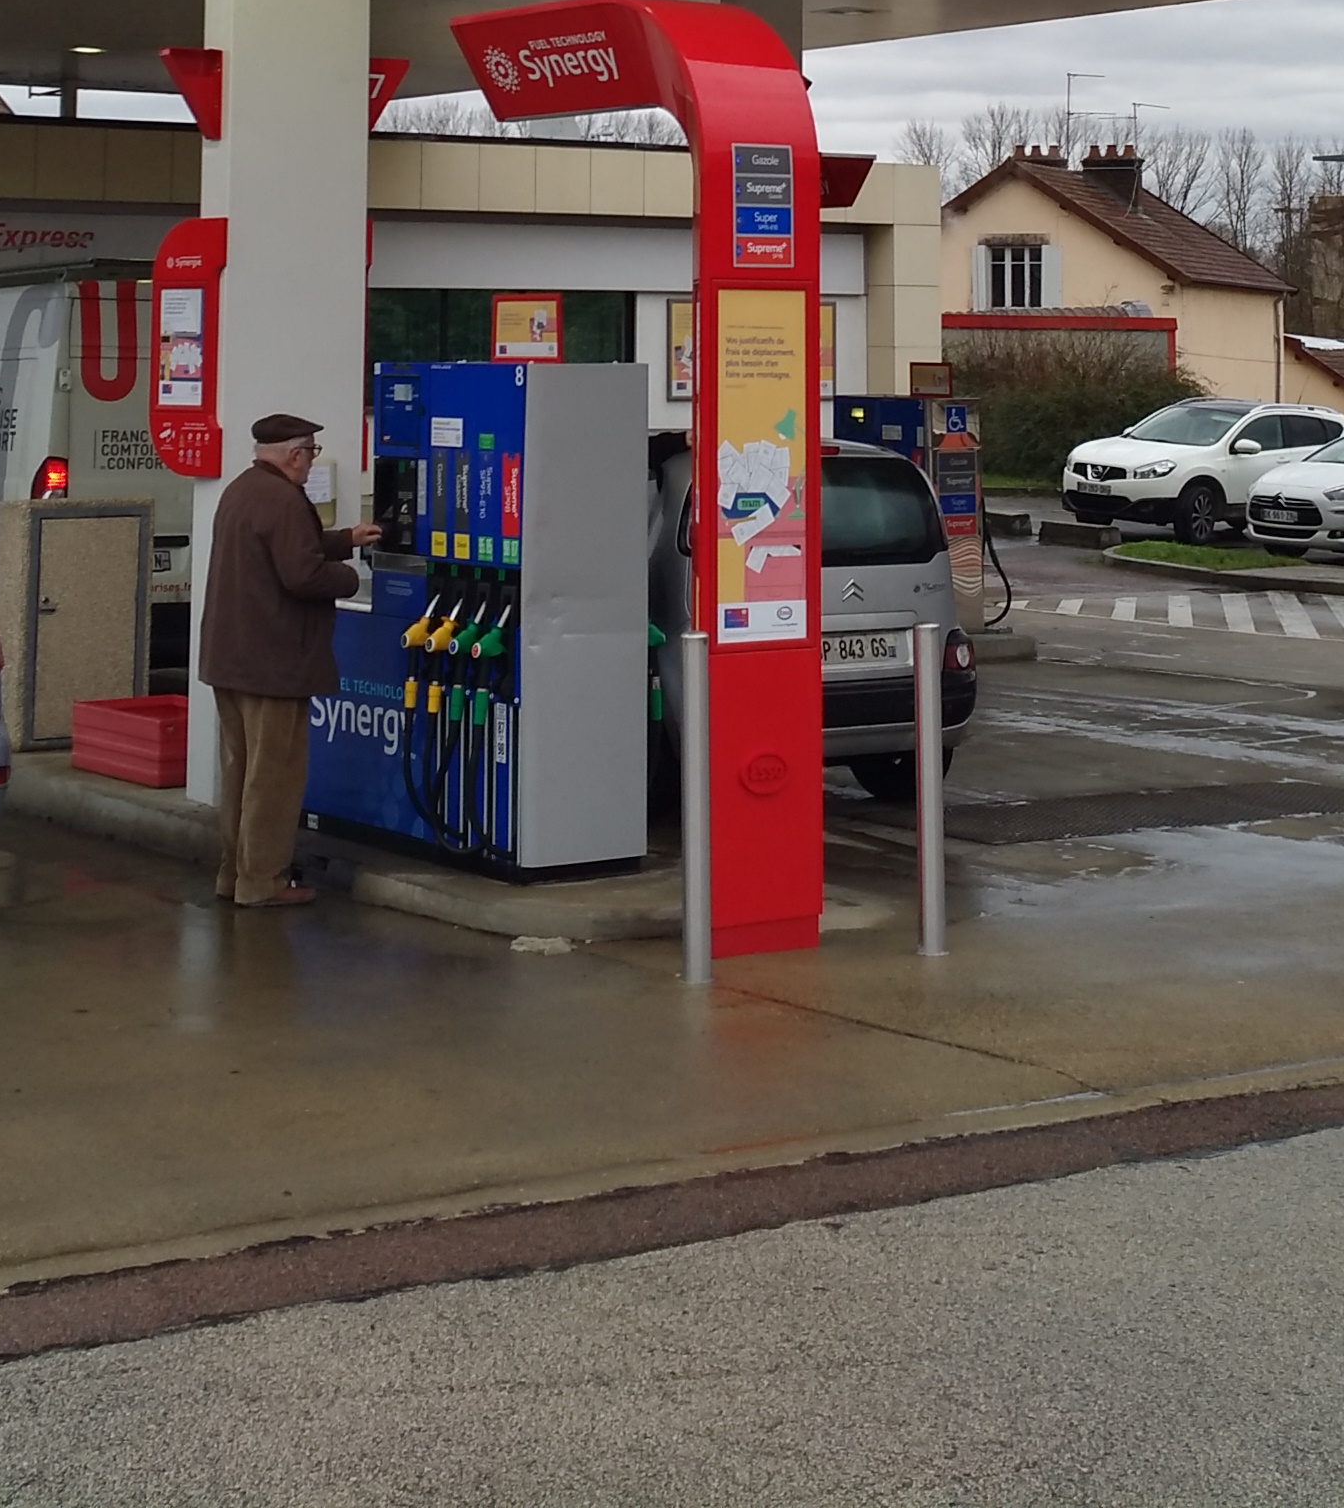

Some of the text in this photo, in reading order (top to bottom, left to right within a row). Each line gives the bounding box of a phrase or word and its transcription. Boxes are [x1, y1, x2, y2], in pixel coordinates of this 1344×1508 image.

[528, 30, 607, 50] FUEL TECHNOLOGY
[518, 46, 620, 88] Synergy
[369, 73, 386, 99] 7
[751, 154, 780, 166] Gazole
[754, 211, 778, 224] Super
[515, 365, 524, 386] 8
[101, 430, 149, 443] FRANC
[101, 443, 157, 456] COMTOI
[107, 457, 168, 470] CONFOR
[340, 677, 404, 701] EL TECHNOLO
